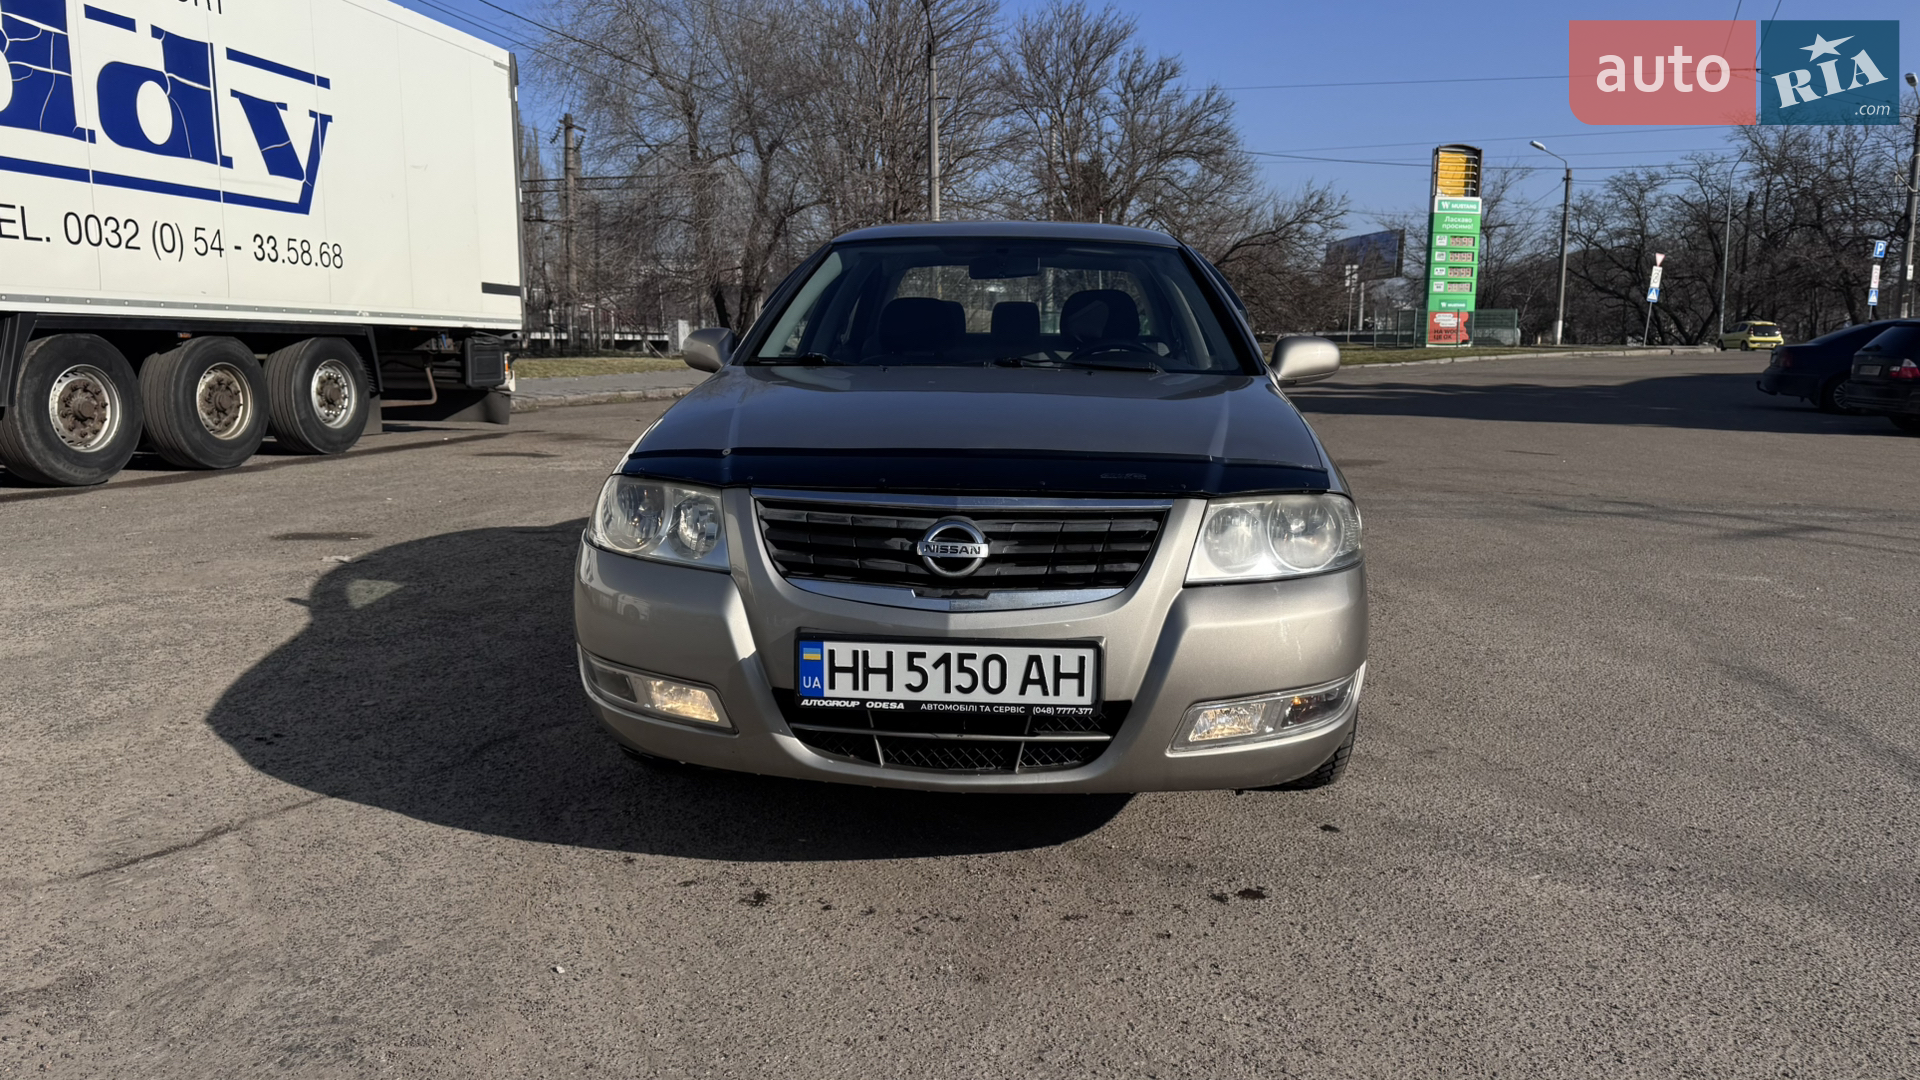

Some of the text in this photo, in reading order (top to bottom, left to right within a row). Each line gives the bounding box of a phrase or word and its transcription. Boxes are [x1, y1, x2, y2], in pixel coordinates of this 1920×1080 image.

[63, 211, 142, 250] 0032
[152, 220, 184, 262] (0)
[194, 227, 225, 258] 54
[252, 233, 344, 269] 33.58.68
[924, 544, 981, 555] NISSAN
[828, 649, 1086, 697] HH 5150 AH
[803, 676, 822, 689] UA
[800, 699, 905, 710] AUTOGROUP ODESA
[920, 703, 1093, 715] АВТОМОБІЛІ ТА СЕРВІС (048) 7777-377
